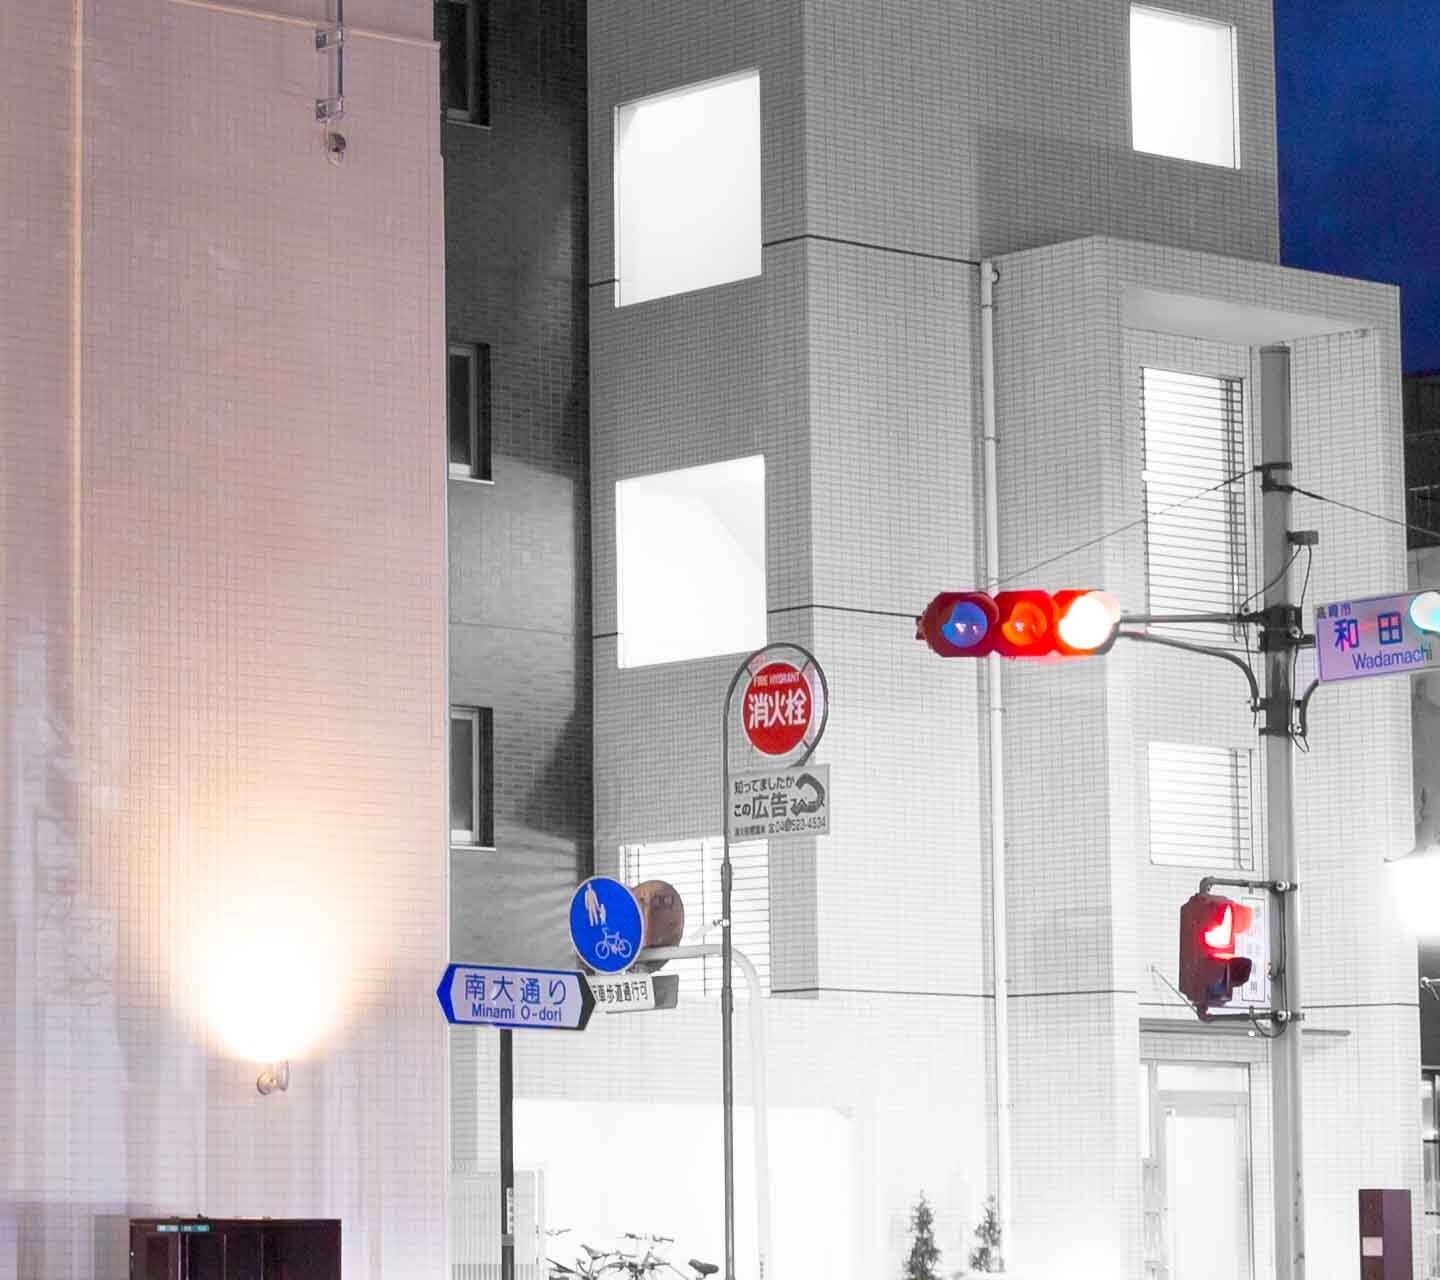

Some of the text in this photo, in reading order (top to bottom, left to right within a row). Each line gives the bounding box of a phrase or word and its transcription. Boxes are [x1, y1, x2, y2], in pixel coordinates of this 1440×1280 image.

[1352, 645, 1433, 671] Wadamachi
[748, 687, 807, 730] 消火栓
[734, 775, 795, 795] 知ってましたか
[463, 973, 567, 1006] 南大通り
[471, 1002, 562, 1022] Minami O-dori
